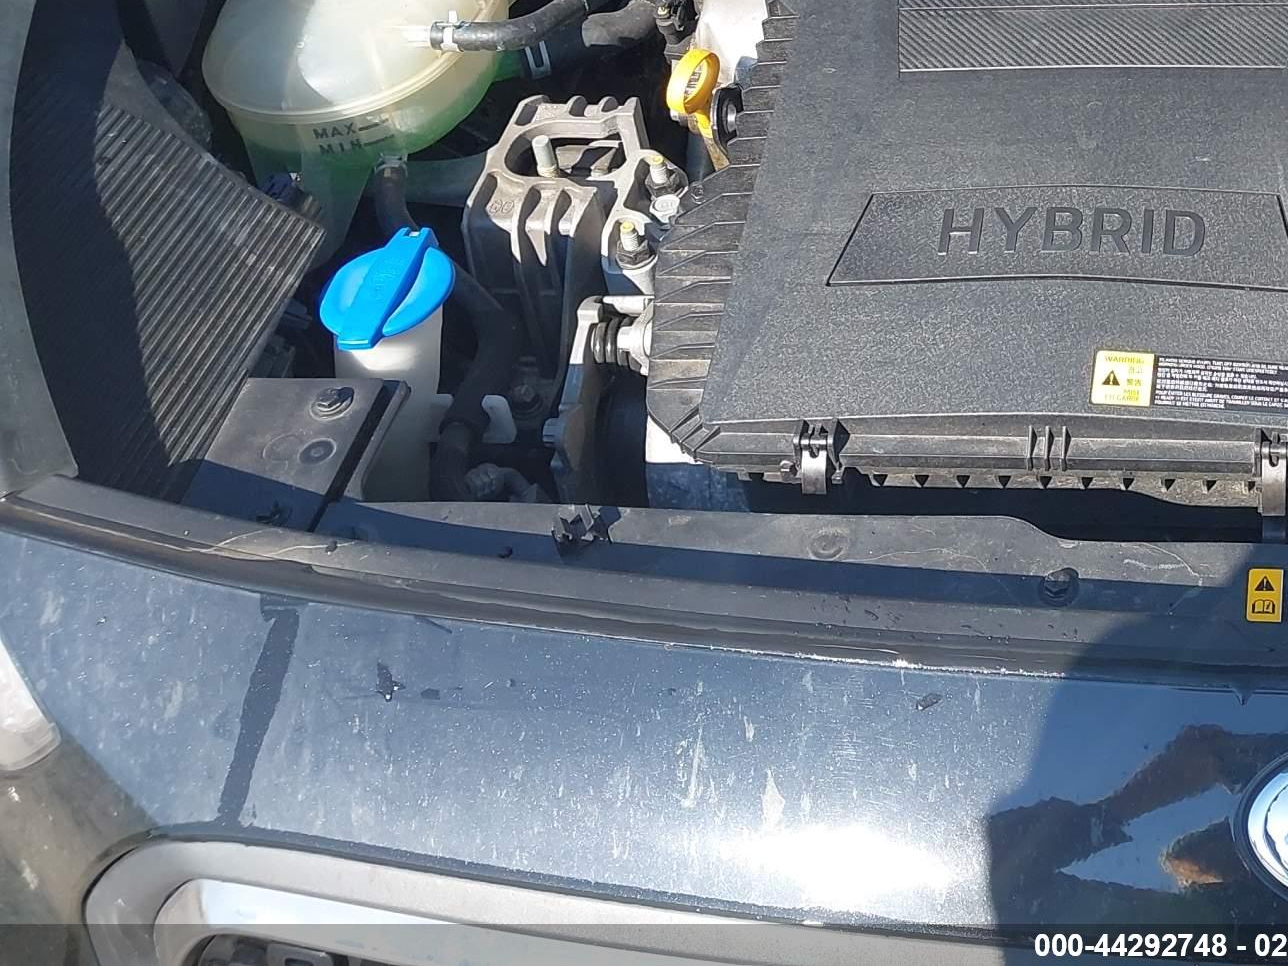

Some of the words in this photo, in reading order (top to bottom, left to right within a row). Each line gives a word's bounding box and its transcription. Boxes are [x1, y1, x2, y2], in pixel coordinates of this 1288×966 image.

[313, 122, 356, 140] MAX
[319, 139, 362, 155] MIN
[937, 206, 1206, 257] HYBRID
